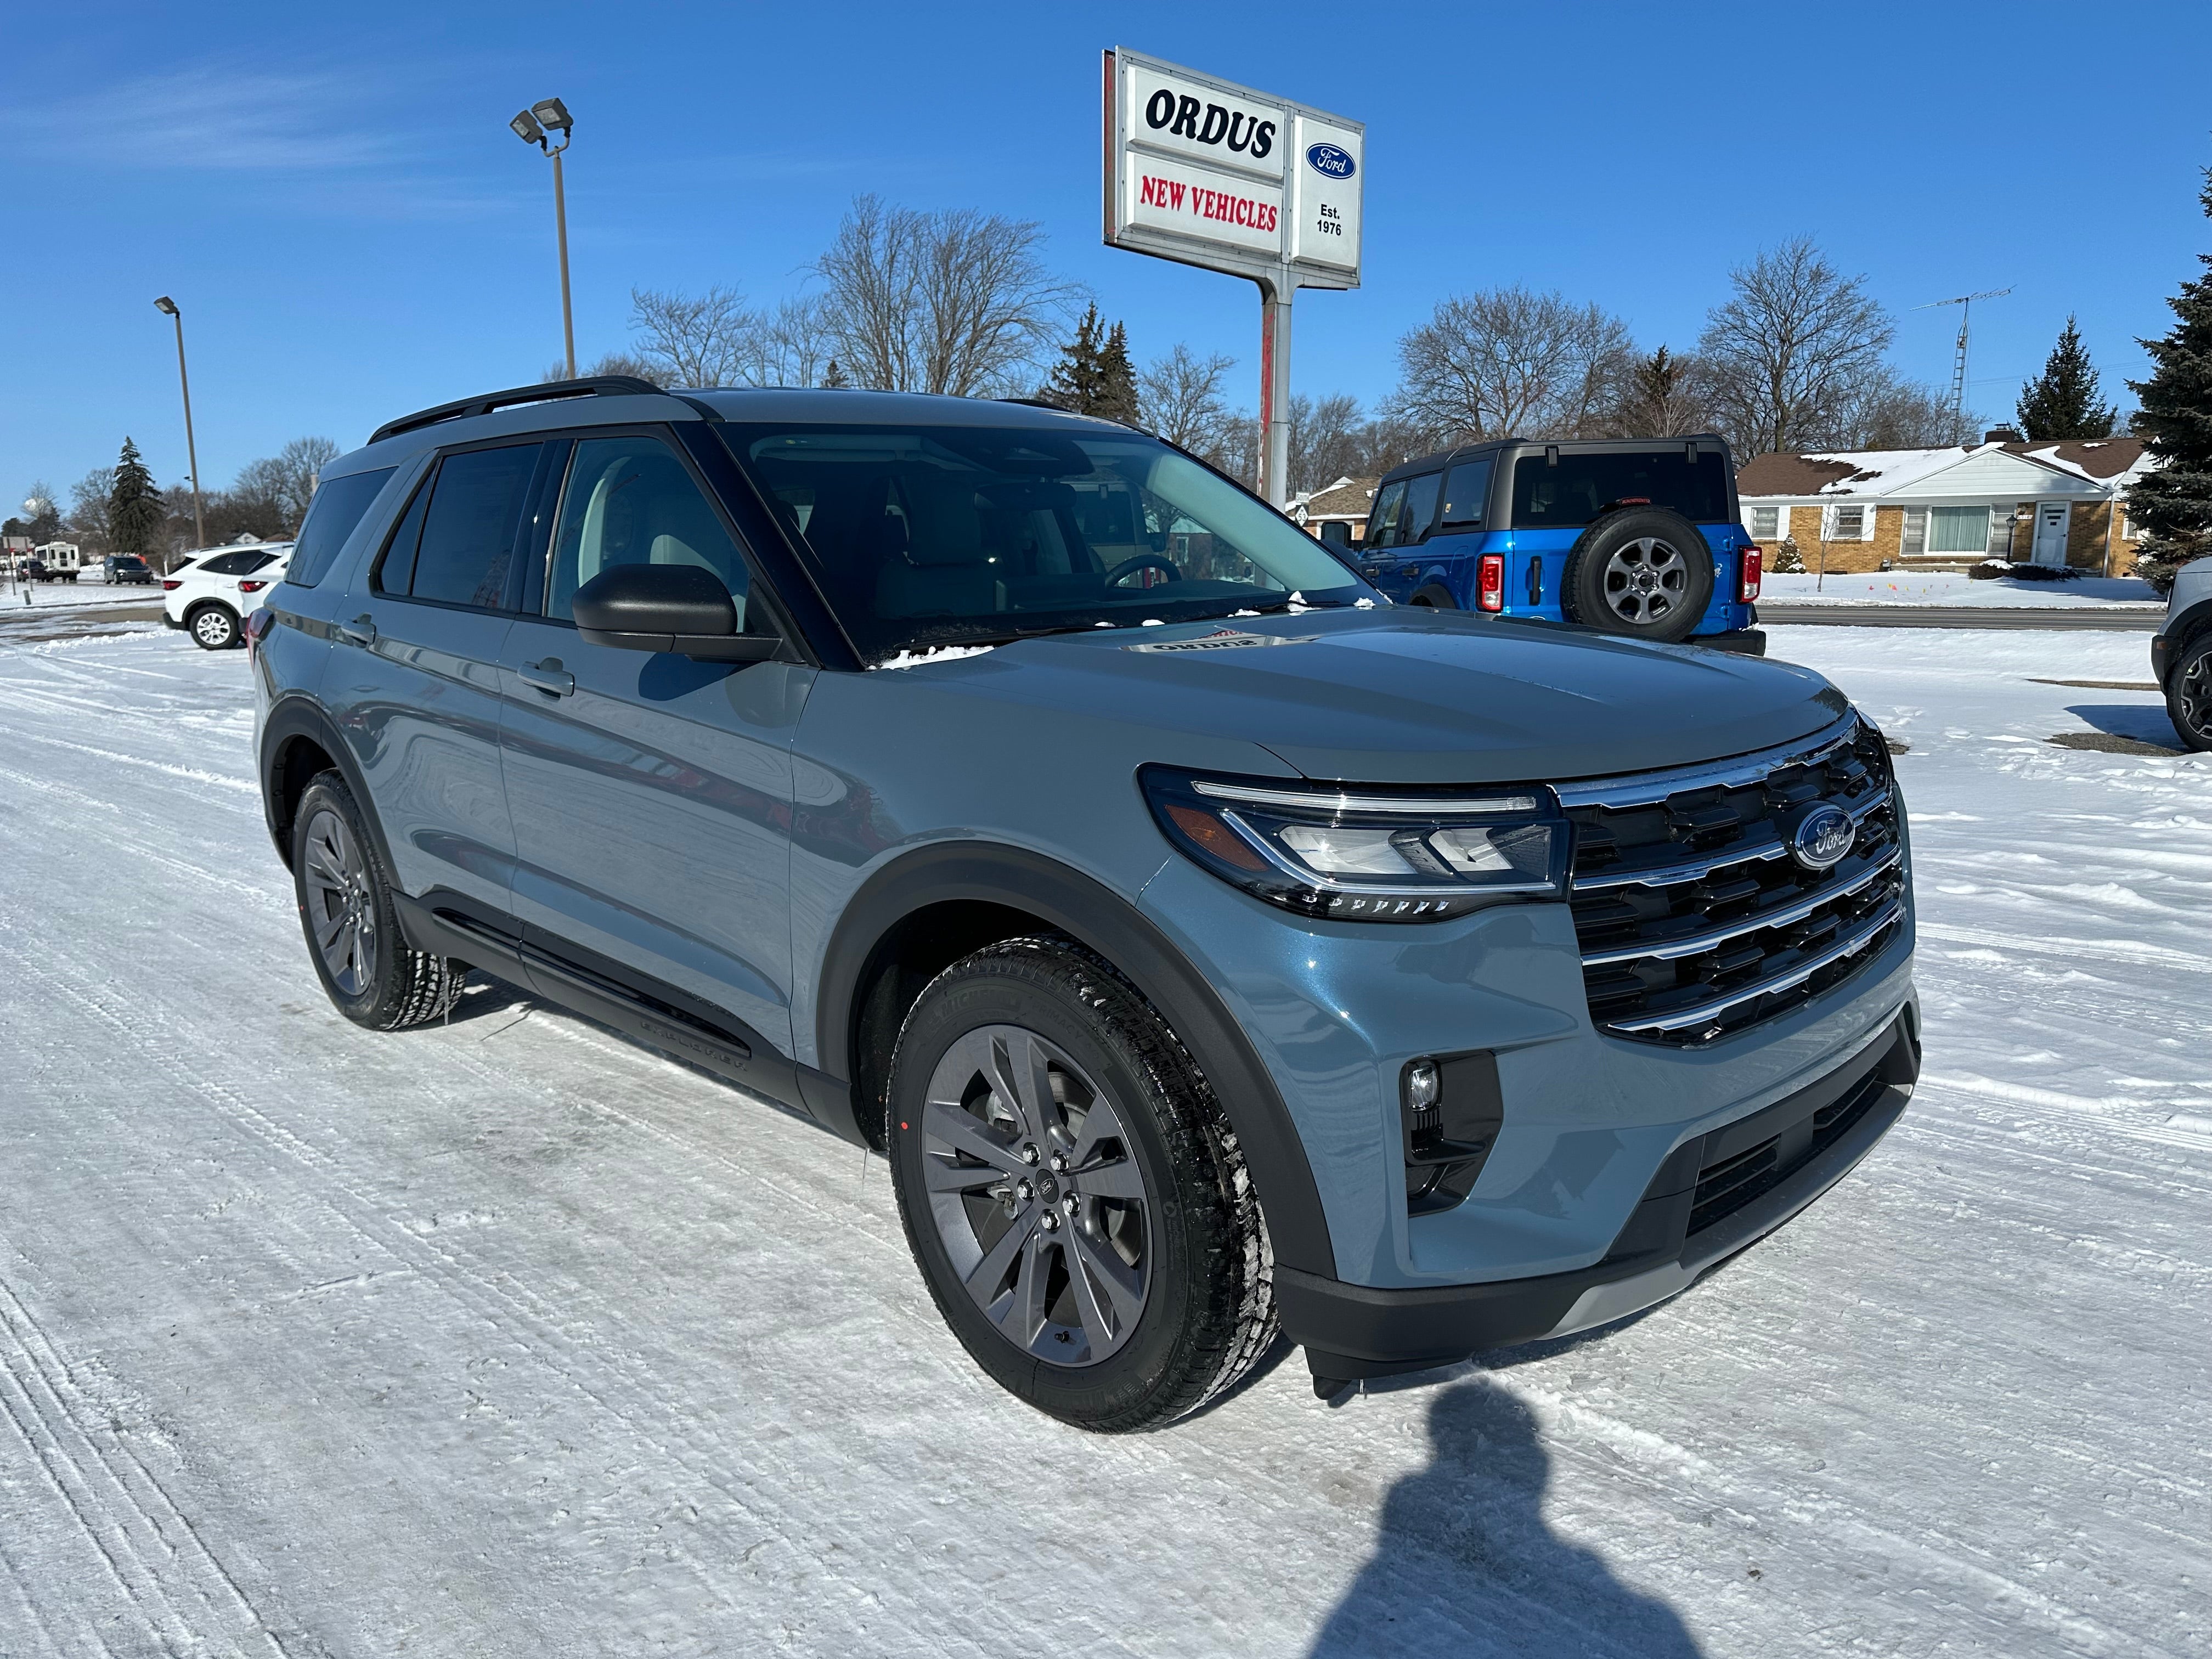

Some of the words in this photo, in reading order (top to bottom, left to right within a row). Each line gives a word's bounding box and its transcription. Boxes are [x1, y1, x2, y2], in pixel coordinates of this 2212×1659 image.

[1146, 89, 1276, 159] ORDUS
[1317, 148, 1346, 174] Ford
[1140, 176, 1186, 212] NEW
[1192, 187, 1277, 232] VEHICLES
[1321, 204, 1340, 220] Est.
[1317, 219, 1342, 236] 1976
[1298, 514, 1306, 522] 53
[1815, 816, 1846, 854] Ford
[940, 989, 1019, 1017] MICHELIN
[1032, 1002, 1084, 1039] PRIMACY
[640, 1021, 748, 1071] EXPLORER
[1041, 1181, 1051, 1193] Ford
